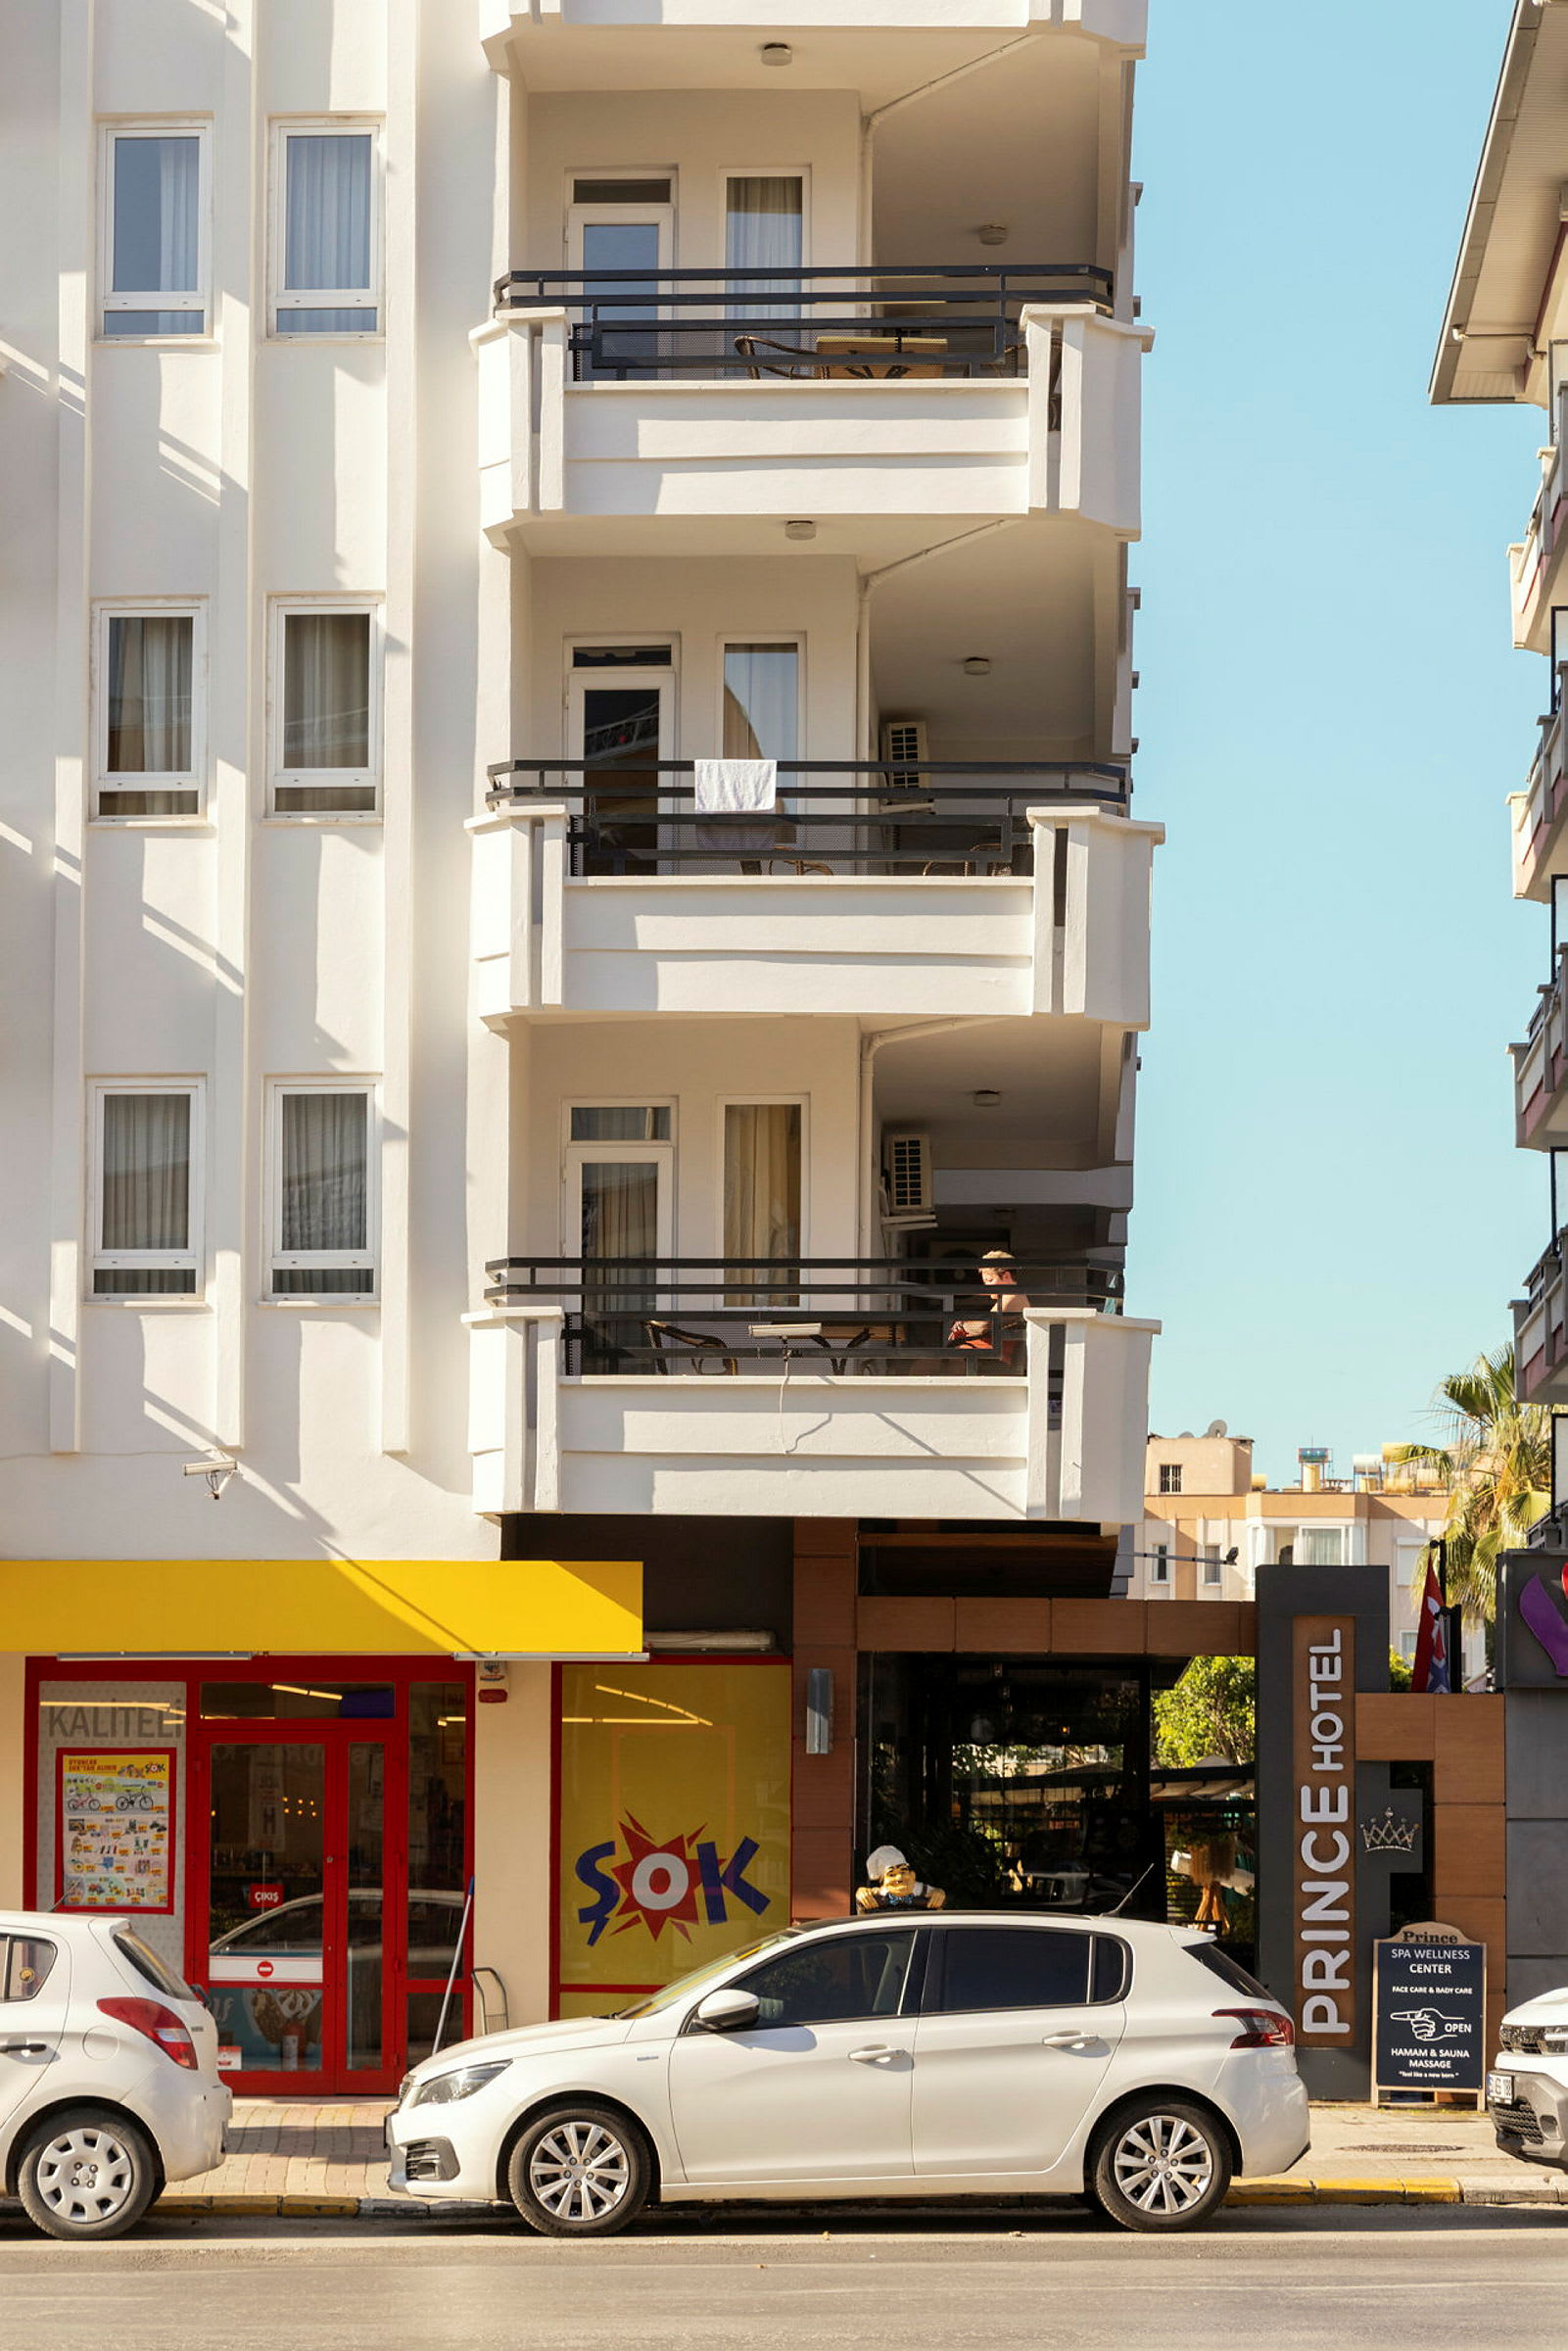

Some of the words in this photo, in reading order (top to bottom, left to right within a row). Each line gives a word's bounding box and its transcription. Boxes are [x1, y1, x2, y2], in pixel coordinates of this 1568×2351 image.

[1309, 1628, 1344, 1771] HOTEL
[49, 1698, 182, 1738] KALİTELİ
[254, 1891, 279, 1903] ÇIKIŞ
[575, 1836, 771, 1946] ŞOK
[1301, 1785, 1351, 2034] PRINCE
[1402, 1931, 1458, 1944] Prince
[1391, 1948, 1411, 1959] SPA
[1413, 1949, 1471, 1960] WELLNESS
[1409, 1963, 1452, 1974] CENTER
[1409, 1986, 1427, 1994] CARE
[1444, 2023, 1472, 2034] OPEN
[1391, 2048, 1428, 2058] HAMAM
[1429, 2048, 1437, 2058] &
[1439, 2048, 1470, 2058] SAUNA
[1408, 2059, 1451, 2069] MASSAGE
